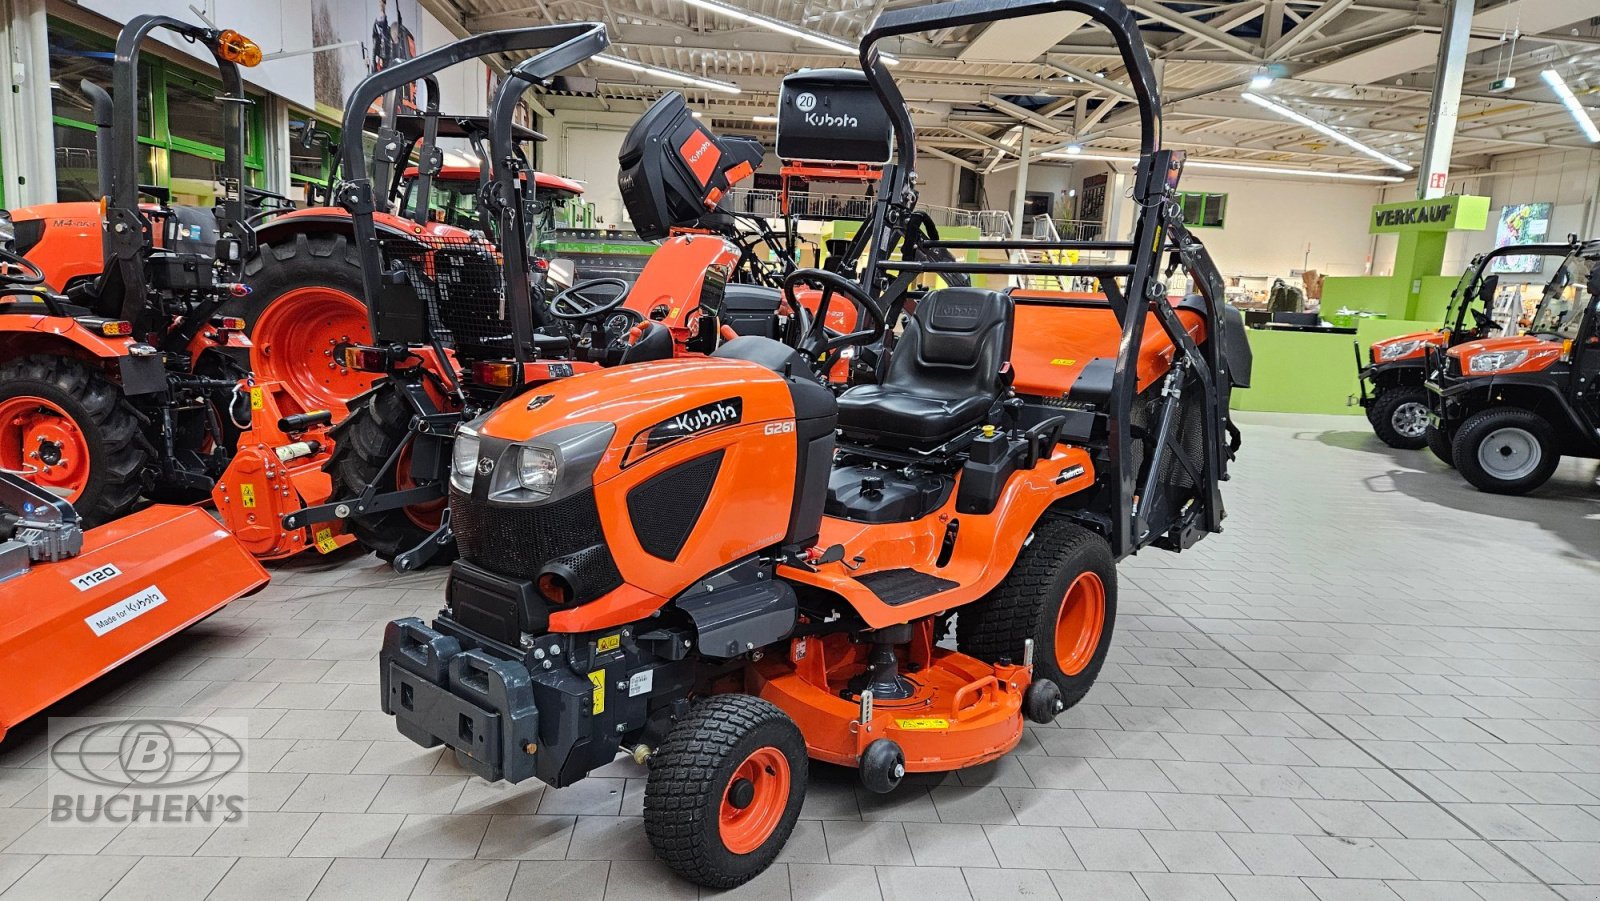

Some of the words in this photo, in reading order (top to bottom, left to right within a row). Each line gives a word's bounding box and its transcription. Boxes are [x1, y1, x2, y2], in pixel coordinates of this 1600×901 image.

[799, 95, 814, 108] 20
[805, 112, 858, 128] Kubota
[689, 141, 711, 163] Kubota
[1375, 204, 1452, 227] VERKAUF
[676, 402, 738, 431] Kubota
[78, 567, 117, 588] 1120
[96, 615, 118, 629] Made
[116, 609, 127, 619] for
[127, 593, 160, 613] Kubota
